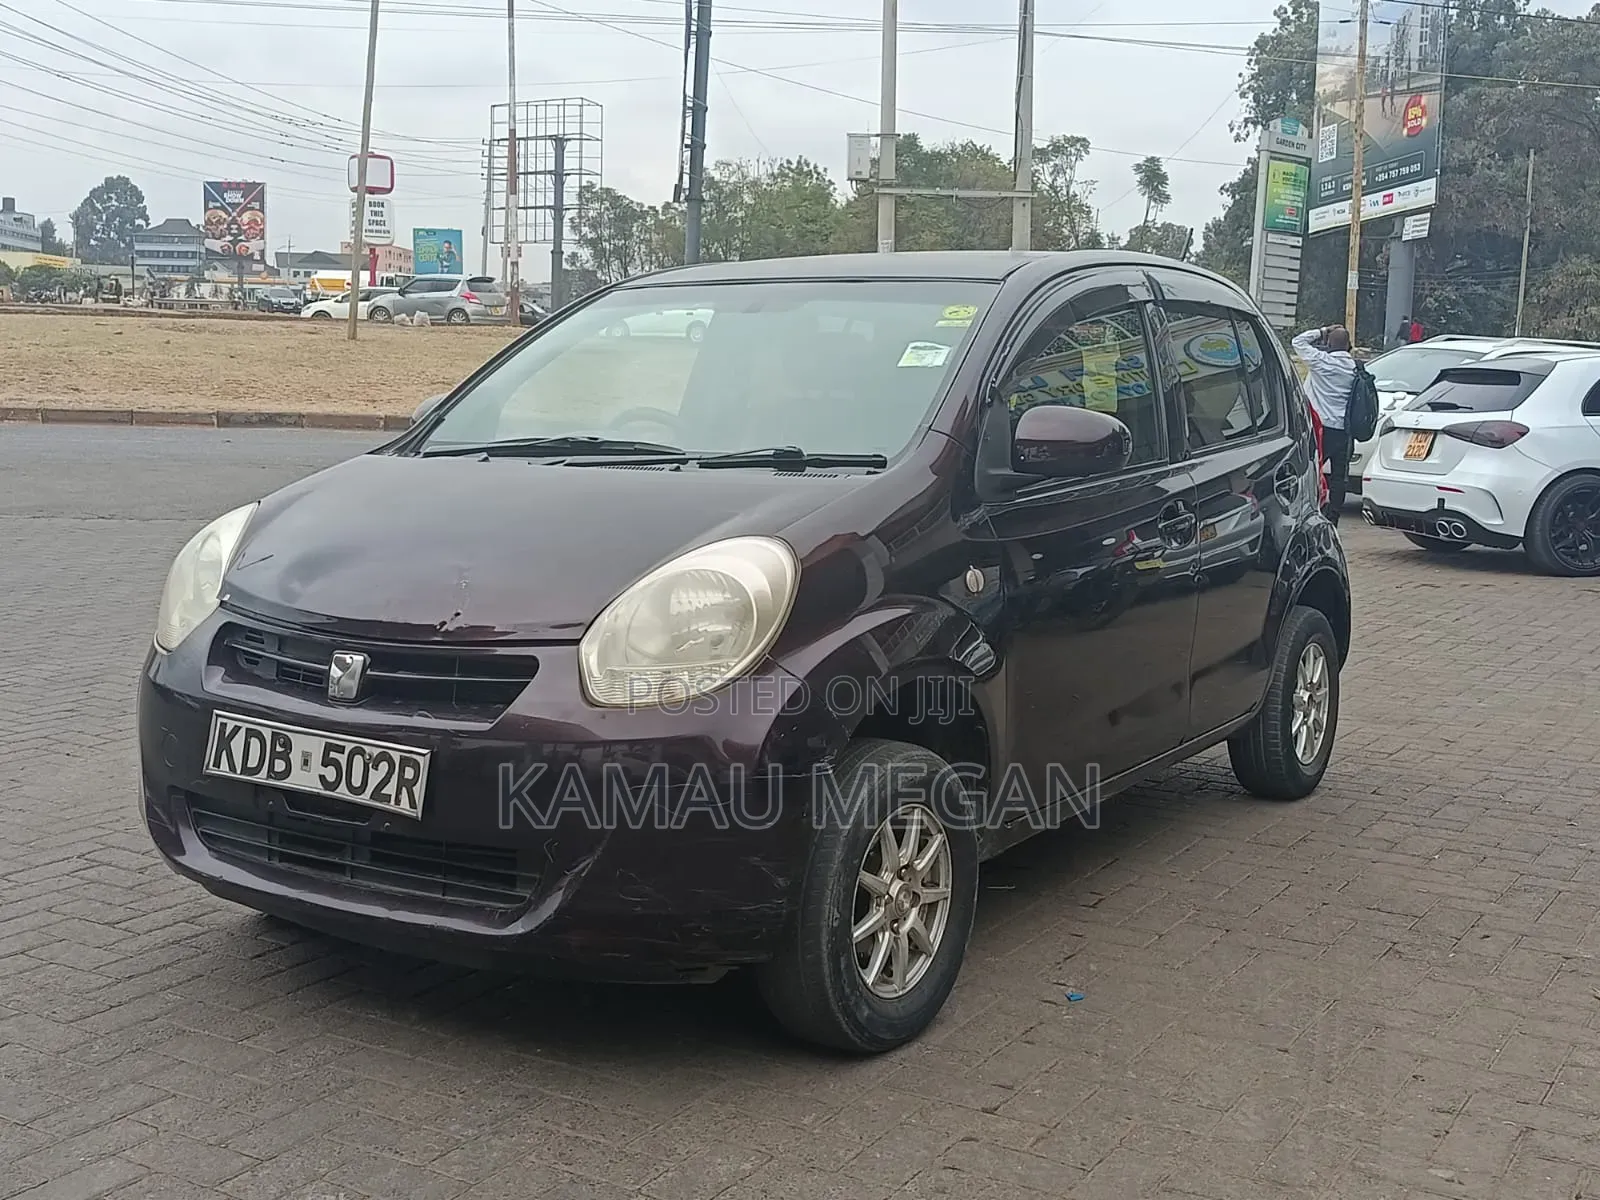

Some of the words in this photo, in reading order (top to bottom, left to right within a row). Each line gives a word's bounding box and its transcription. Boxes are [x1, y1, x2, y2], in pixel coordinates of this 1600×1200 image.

[1276, 137, 1295, 149] GARDEN
[1296, 142, 1306, 151] CITY
[368, 219, 386, 227] SPACE
[212, 722, 293, 781] KDB
[318, 741, 421, 810] 502R
